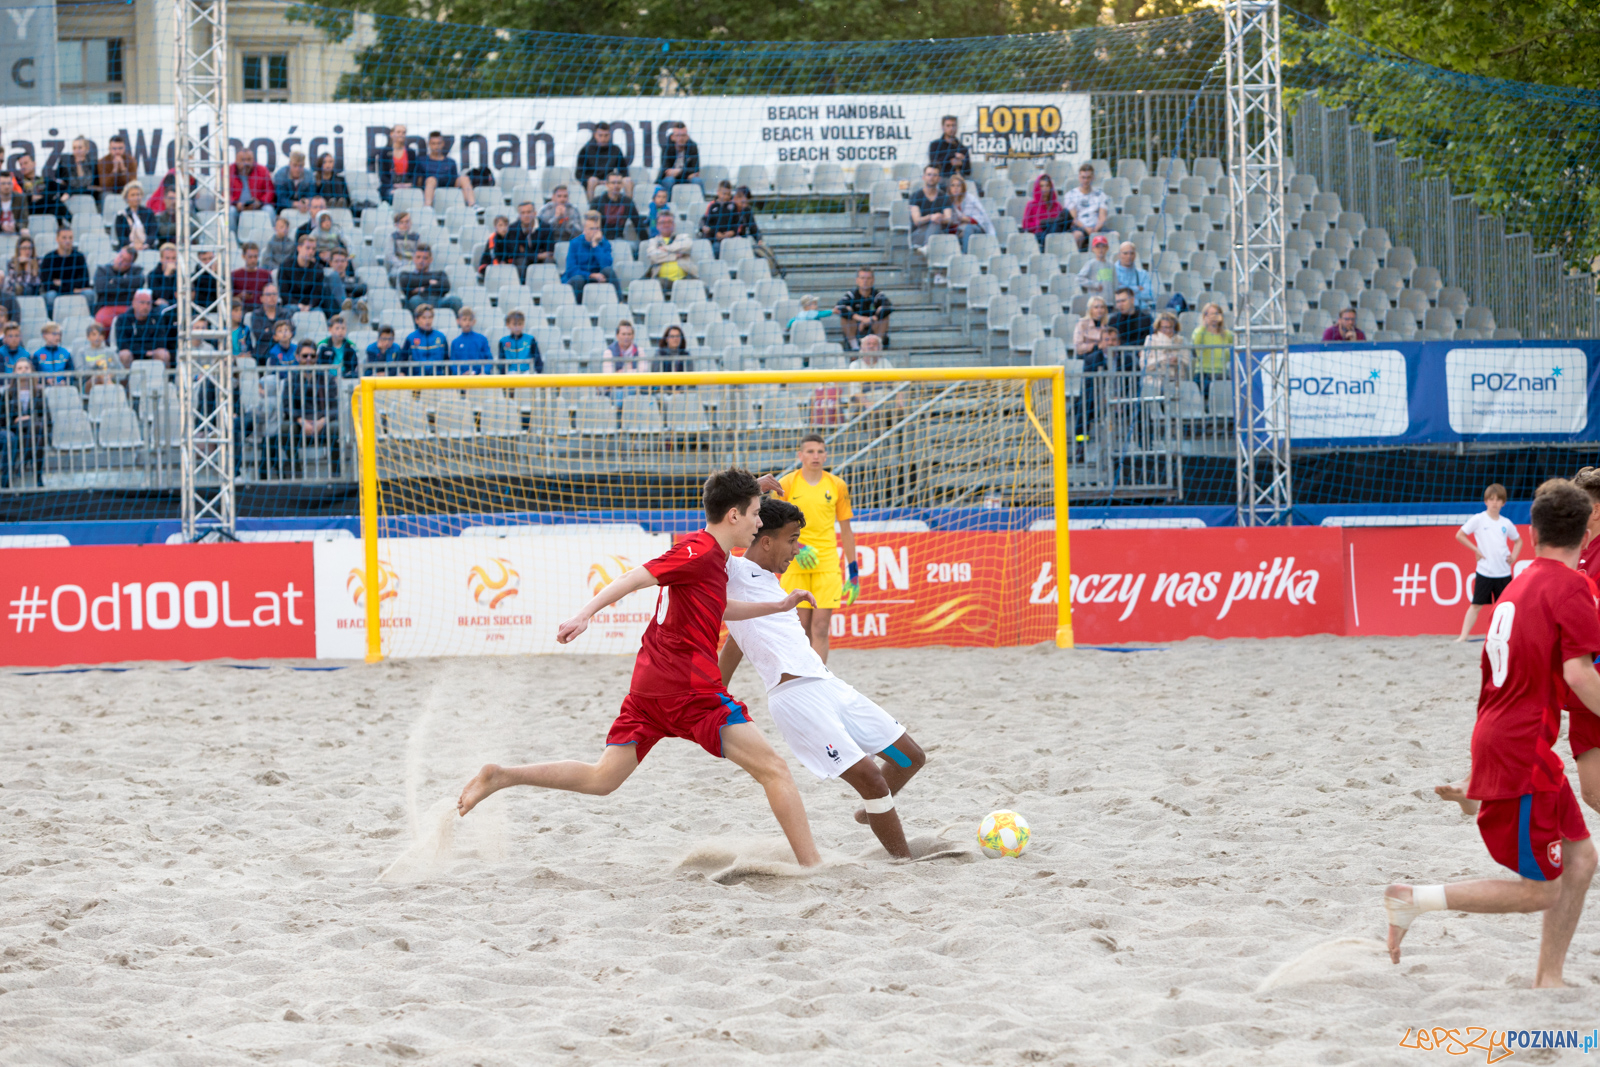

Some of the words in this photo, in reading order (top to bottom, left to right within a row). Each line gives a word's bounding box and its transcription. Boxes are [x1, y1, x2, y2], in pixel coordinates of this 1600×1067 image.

[767, 106, 819, 120] BEACH
[827, 105, 906, 119] HANDBALL
[978, 105, 1062, 133] LOTTO
[762, 127, 814, 141] BEACH
[821, 126, 912, 140] VOLLEYBALL
[1008, 131, 1078, 154] Wolności
[778, 148, 829, 161] BEACH
[837, 146, 897, 160] SOCCER
[926, 562, 971, 582] 2019
[1150, 571, 1222, 608] nas
[1216, 556, 1320, 621] piłka
[8, 580, 303, 633] #Od100Lat
[337, 618, 367, 629] BEAC
[379, 617, 412, 628] OCCER
[458, 616, 490, 627] BEACH
[493, 614, 532, 626] SOCCER
[851, 612, 889, 637] LAT
